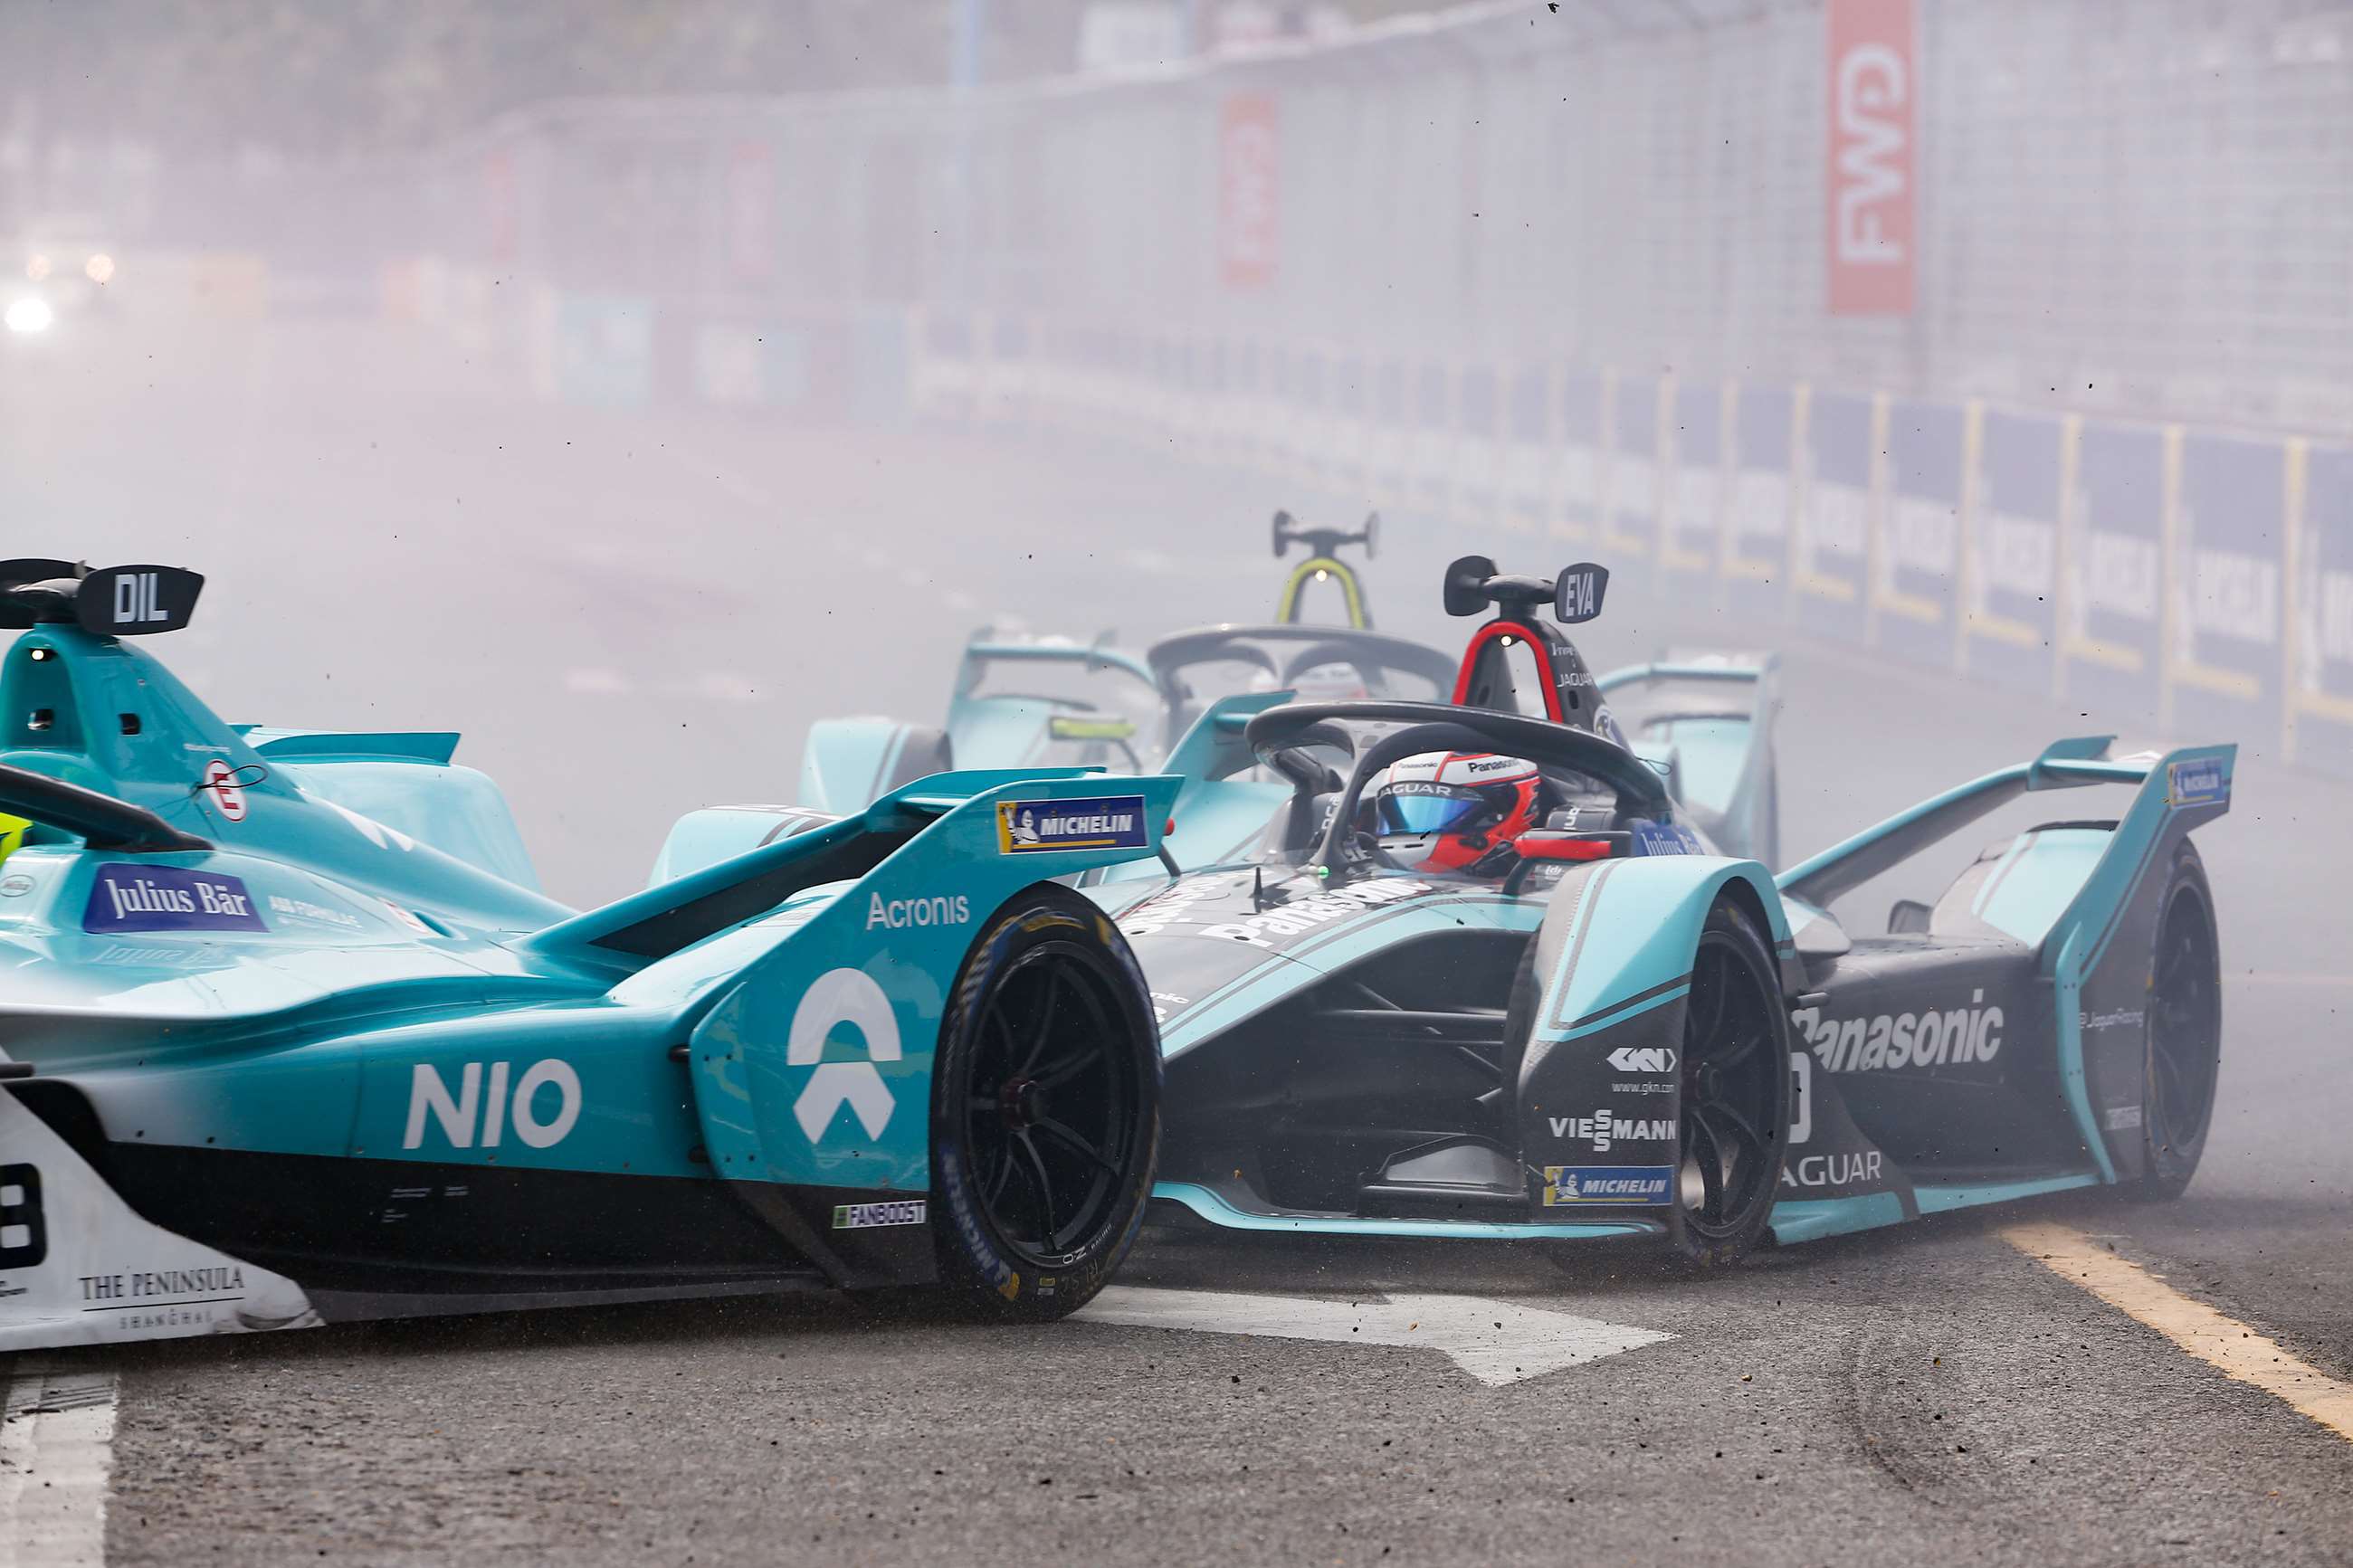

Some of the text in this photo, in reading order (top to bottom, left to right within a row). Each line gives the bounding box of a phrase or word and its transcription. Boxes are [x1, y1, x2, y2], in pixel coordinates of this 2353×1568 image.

[1835, 42, 1906, 264] FWD
[113, 573, 169, 624] DIL
[1566, 572, 1595, 617] EVA
[1041, 813, 1133, 837] MICHELIN
[104, 879, 249, 920] Julius Bär
[865, 891, 970, 931] Acronis
[1791, 988, 2004, 1073] Panasonic
[403, 1058, 582, 1149] NIO
[1548, 1109, 1677, 1152] VIESSMANN
[1583, 1180, 1666, 1193] MICHELIN
[1781, 1150, 1881, 1187] AGUAR
[80, 1266, 245, 1300] THE PENINSULA
